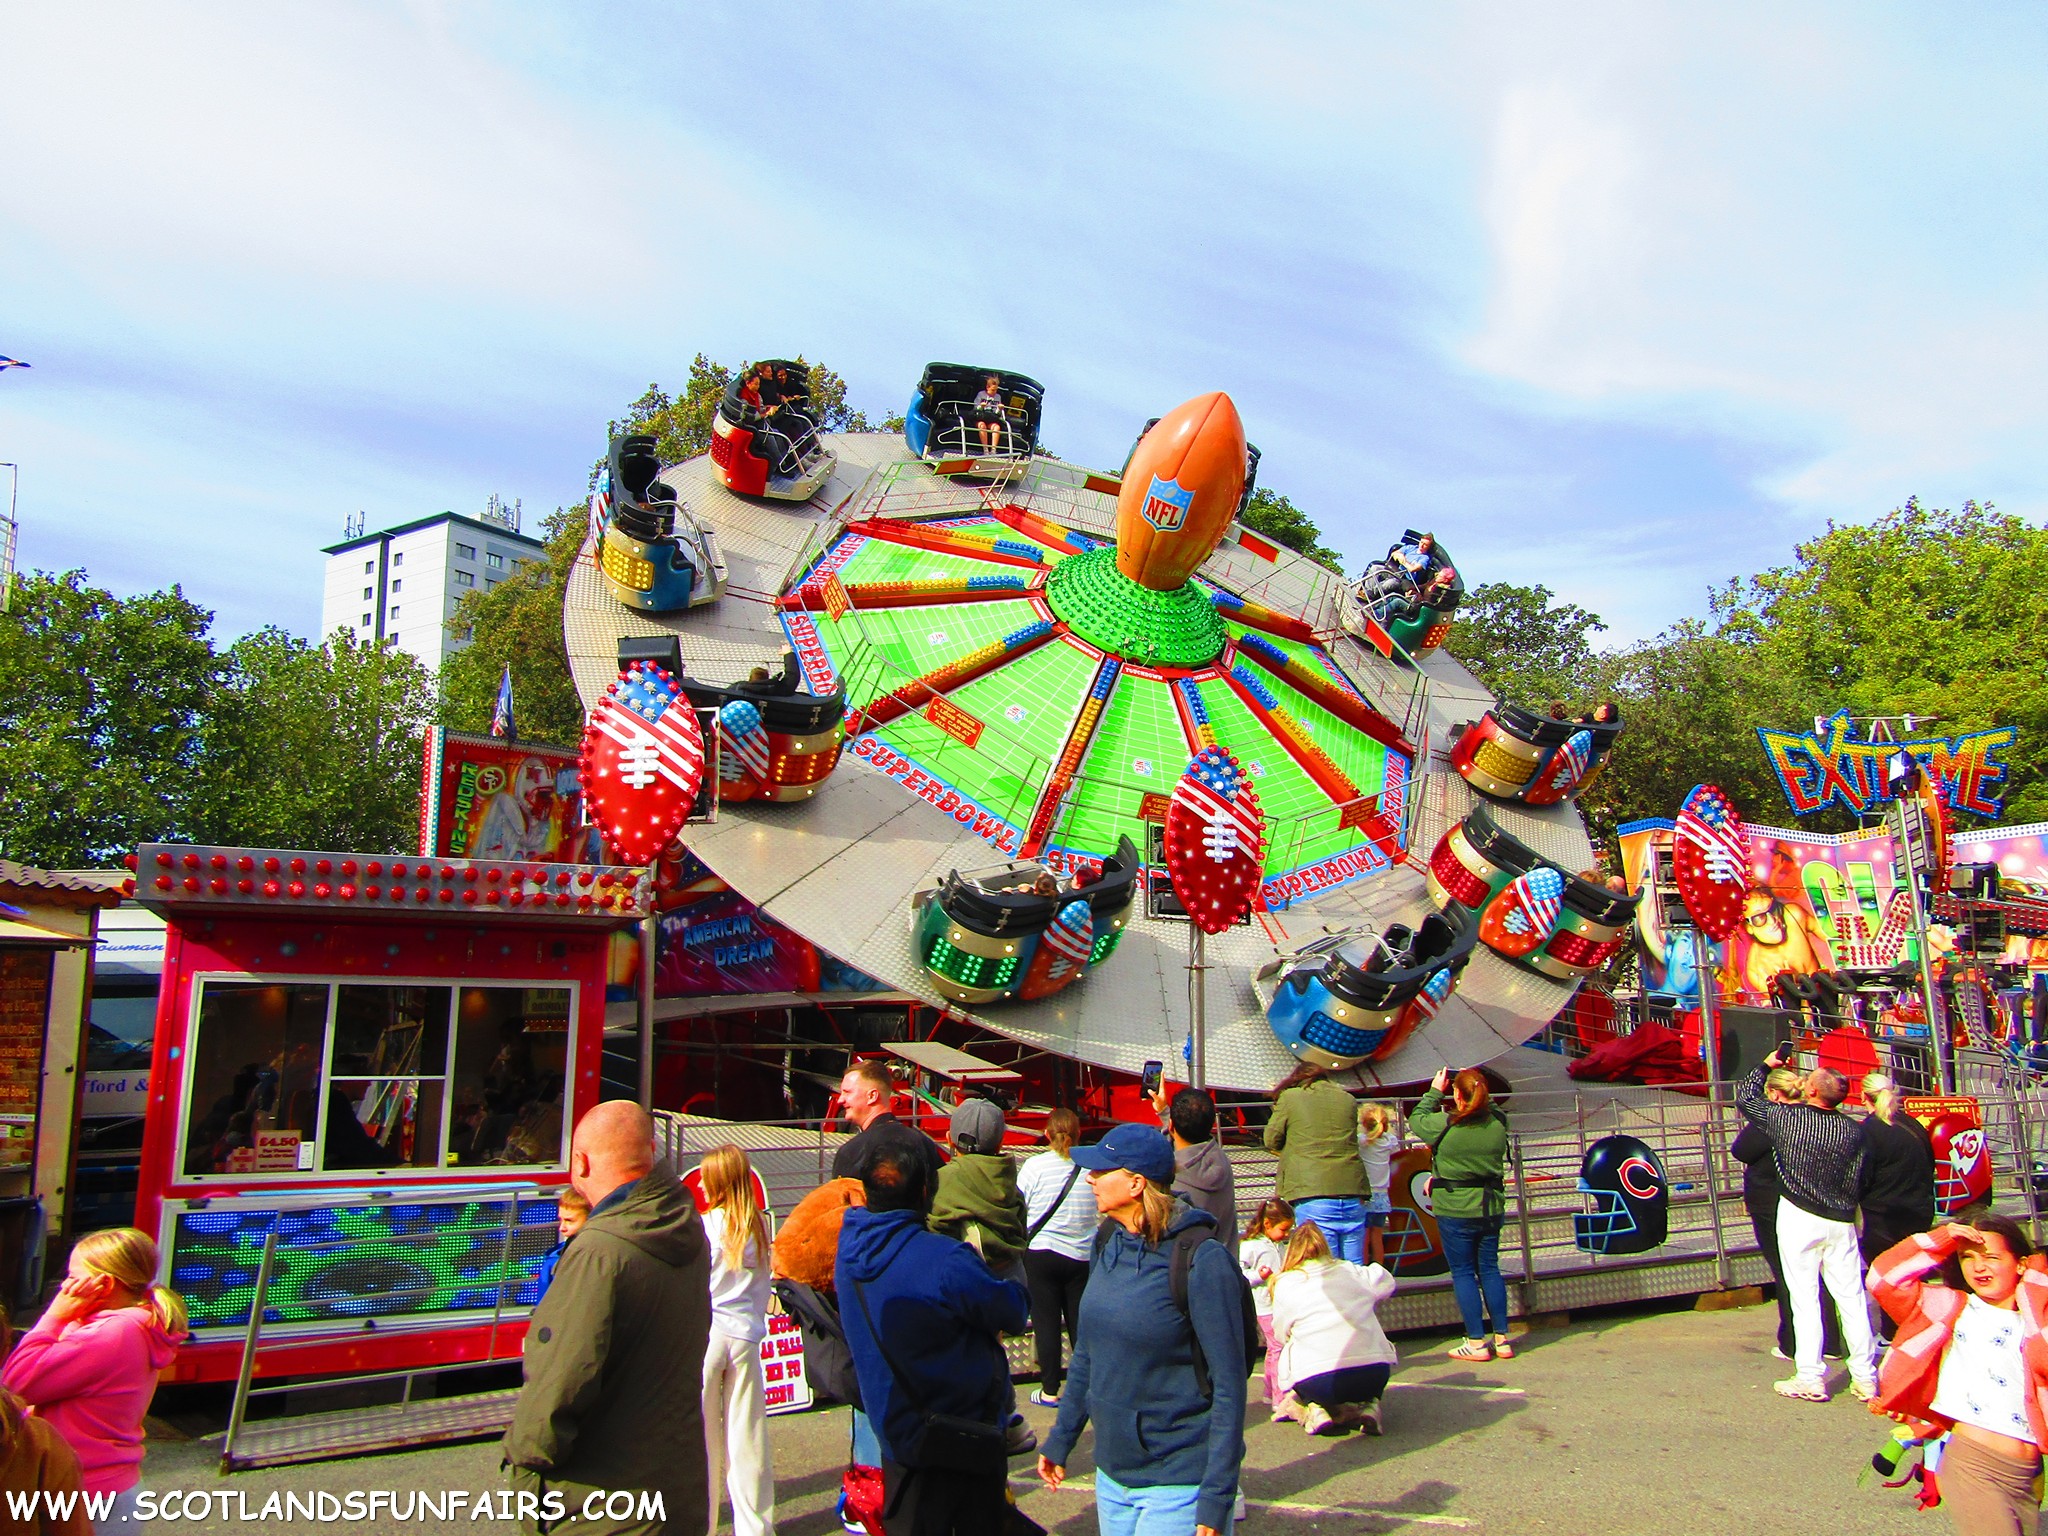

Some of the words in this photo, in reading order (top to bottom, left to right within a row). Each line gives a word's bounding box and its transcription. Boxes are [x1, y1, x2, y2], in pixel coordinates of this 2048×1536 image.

[1145, 495, 1179, 526] NFL
[935, 711, 947, 722] THE
[947, 720, 962, 732] CAR
[939, 701, 956, 714] KEEP
[956, 713, 976, 727] ARMS
[940, 708, 956, 721] LEGS
[956, 719, 977, 735] INSIDE
[934, 719, 947, 729] ALL
[947, 726, 966, 741] TIMES
[1756, 708, 2017, 820] EXTRME
[449, 761, 478, 854] REDSKINS
[854, 738, 1018, 855] SUPERBOWL
[1261, 845, 1388, 907] SUPERBOWL
[663, 916, 689, 934] The
[683, 914, 751, 949] AMERICAN
[714, 936, 774, 968] DREAM
[134, 1078, 149, 1092] &
[1908, 1102, 1941, 1113] SAFETY
[1943, 1102, 1969, 1113] FIRST
[259, 1137, 299, 1147] £4.50
[1616, 1156, 1659, 1199] C
[761, 1341, 775, 1360] AS
[776, 1336, 804, 1357] TALL
[786, 1359, 801, 1379] TO
